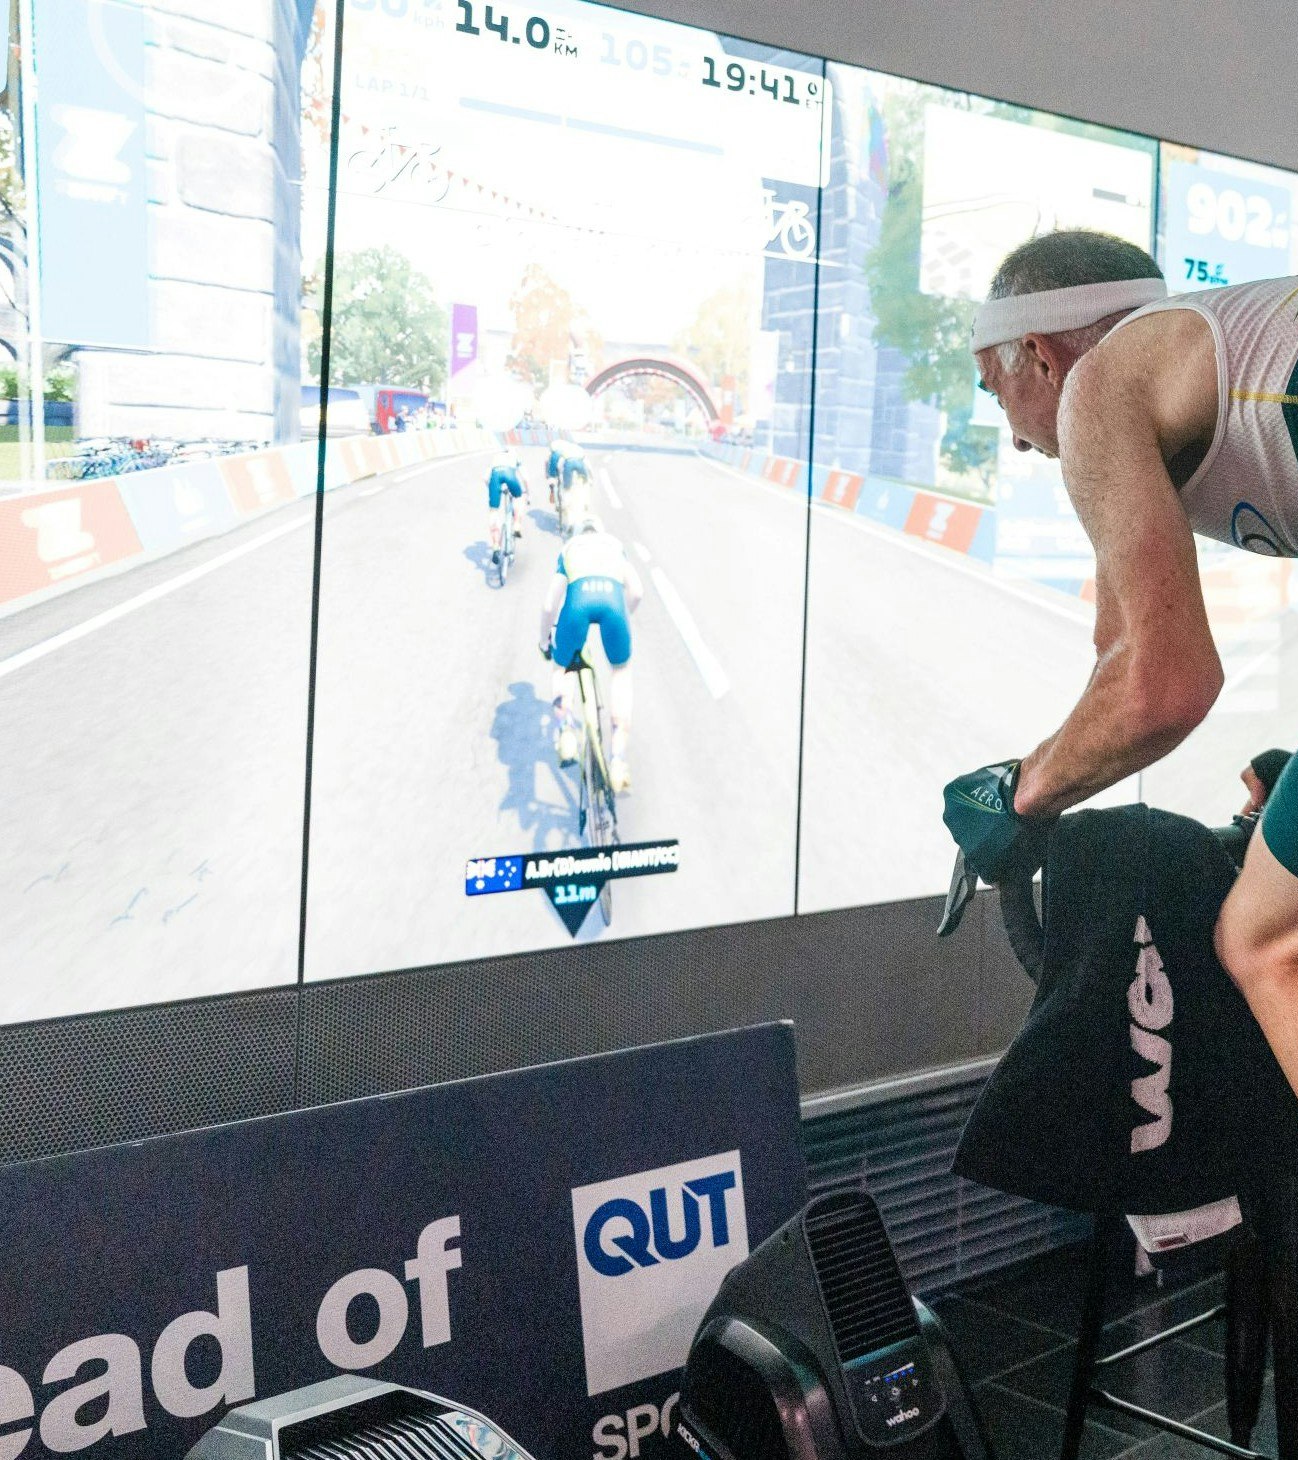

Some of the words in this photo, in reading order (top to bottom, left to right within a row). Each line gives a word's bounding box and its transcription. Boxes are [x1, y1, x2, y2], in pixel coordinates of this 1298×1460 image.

[456, 0, 550, 49] 14.0
[554, 43, 578, 58] KM
[702, 56, 800, 105] 19:41
[1185, 258, 1208, 282] 75
[970, 786, 1003, 811] AERO
[555, 885, 597, 905] 11m
[583, 1170, 736, 1277] QUT
[316, 1215, 463, 1370] of
[886, 1407, 920, 1427] wahoo
